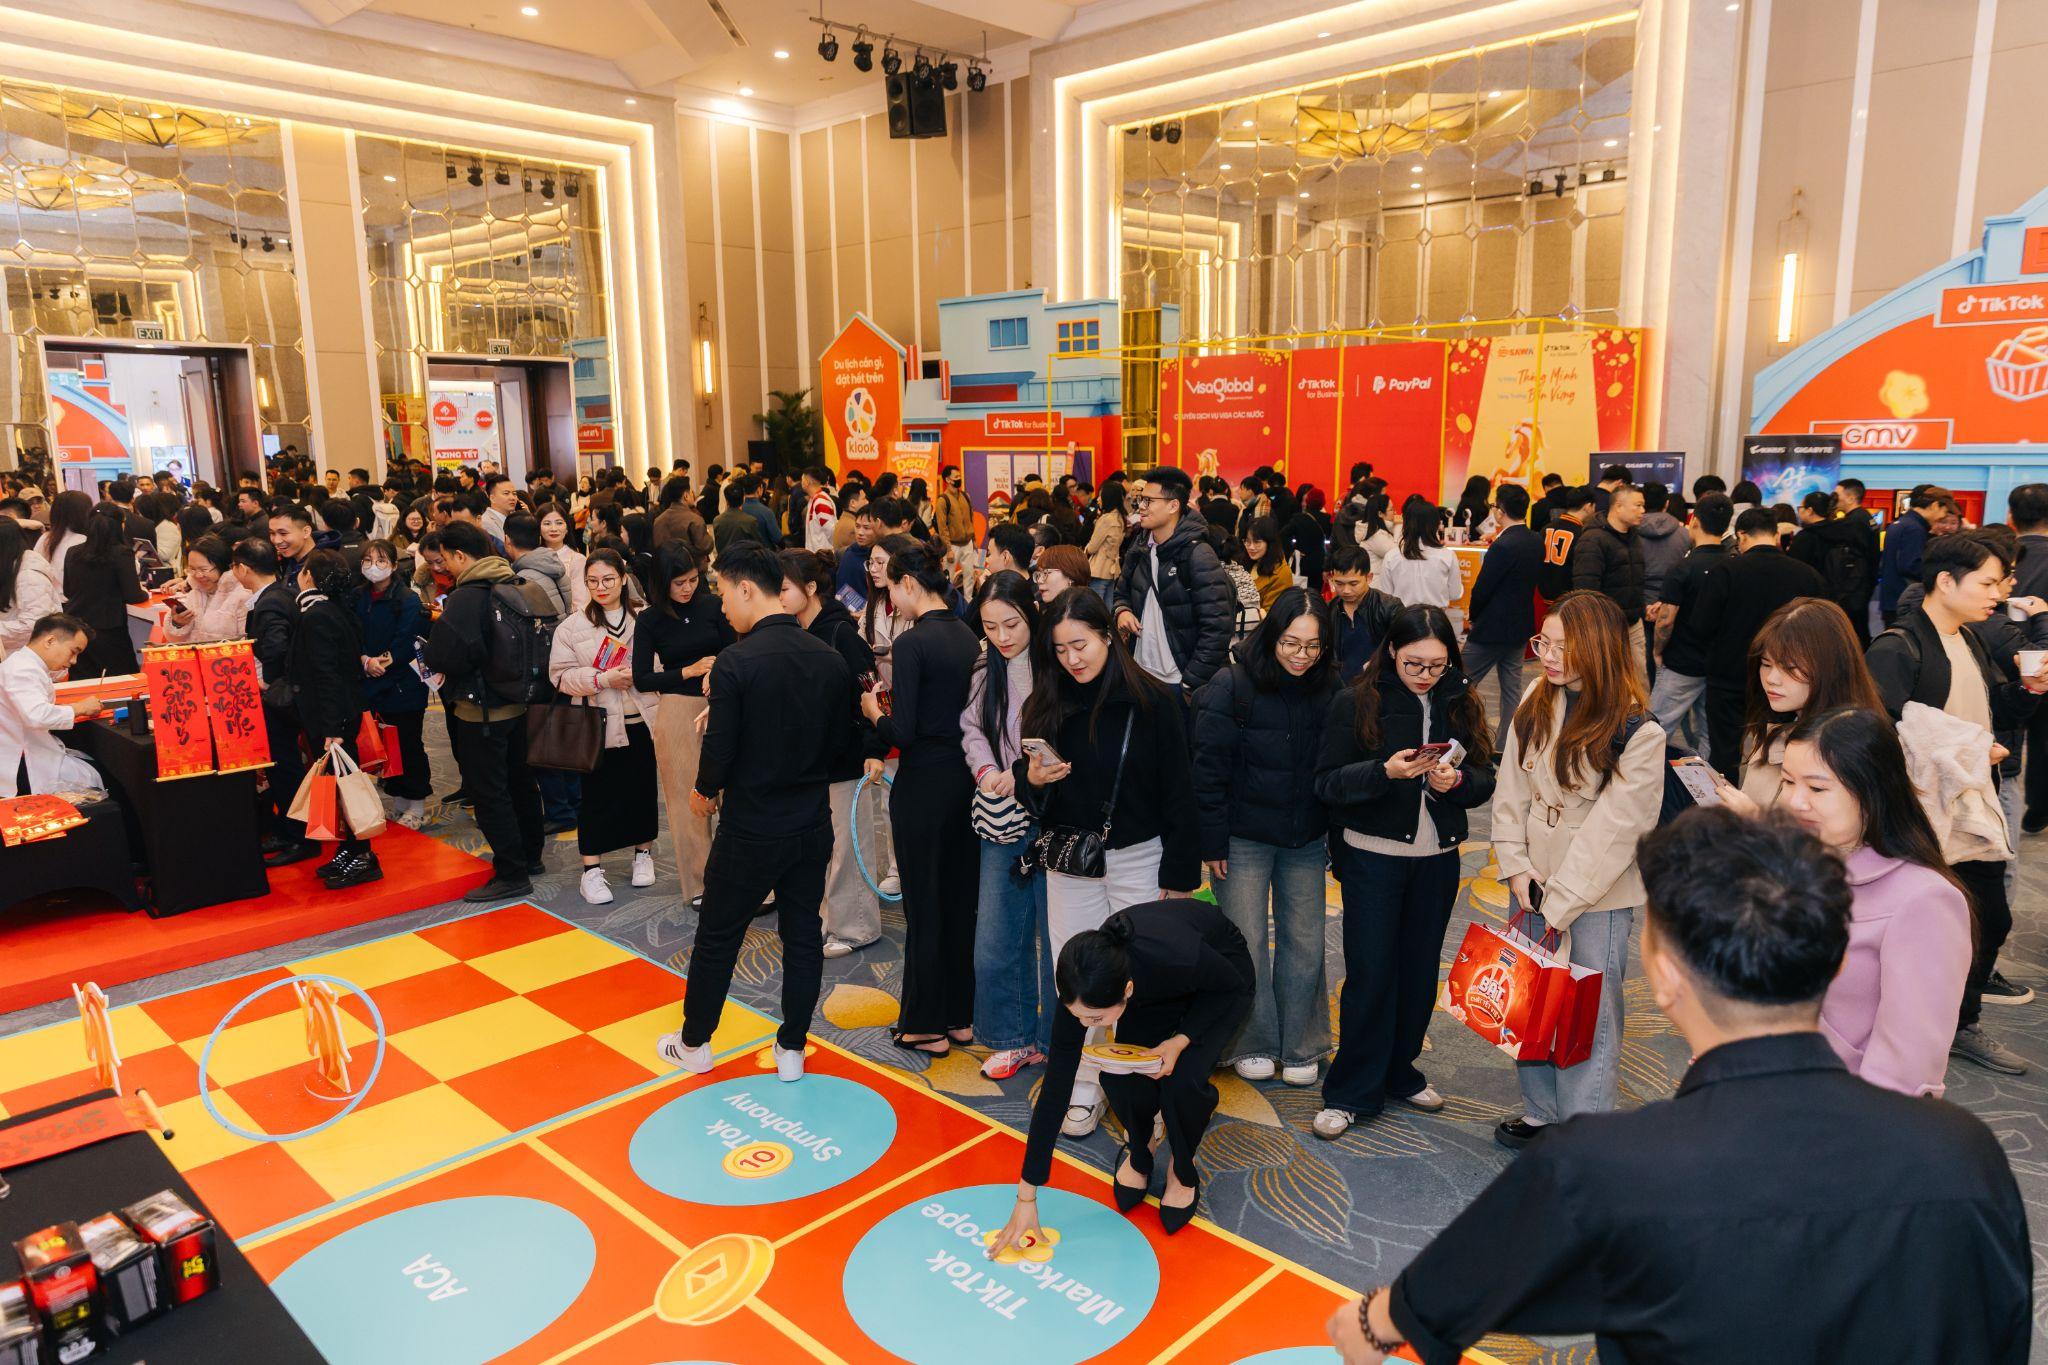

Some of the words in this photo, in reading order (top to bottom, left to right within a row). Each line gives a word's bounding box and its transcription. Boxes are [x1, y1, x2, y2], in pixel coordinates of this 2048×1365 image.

[1980, 294, 2045, 312] TikTok
[139, 329, 162, 339] EXIT
[492, 344, 510, 354] EXIT
[1307, 379, 1335, 389] TikTok
[1389, 377, 1432, 392] PayPal
[848, 441, 876, 454] klook
[1544, 528, 1574, 566] 10
[722, 1092, 842, 1162] Symphony
[739, 1150, 775, 1169] 10
[401, 1252, 469, 1302] ACA
[925, 1249, 1029, 1320] TikTok
[1018, 1259, 1125, 1326] Marke
